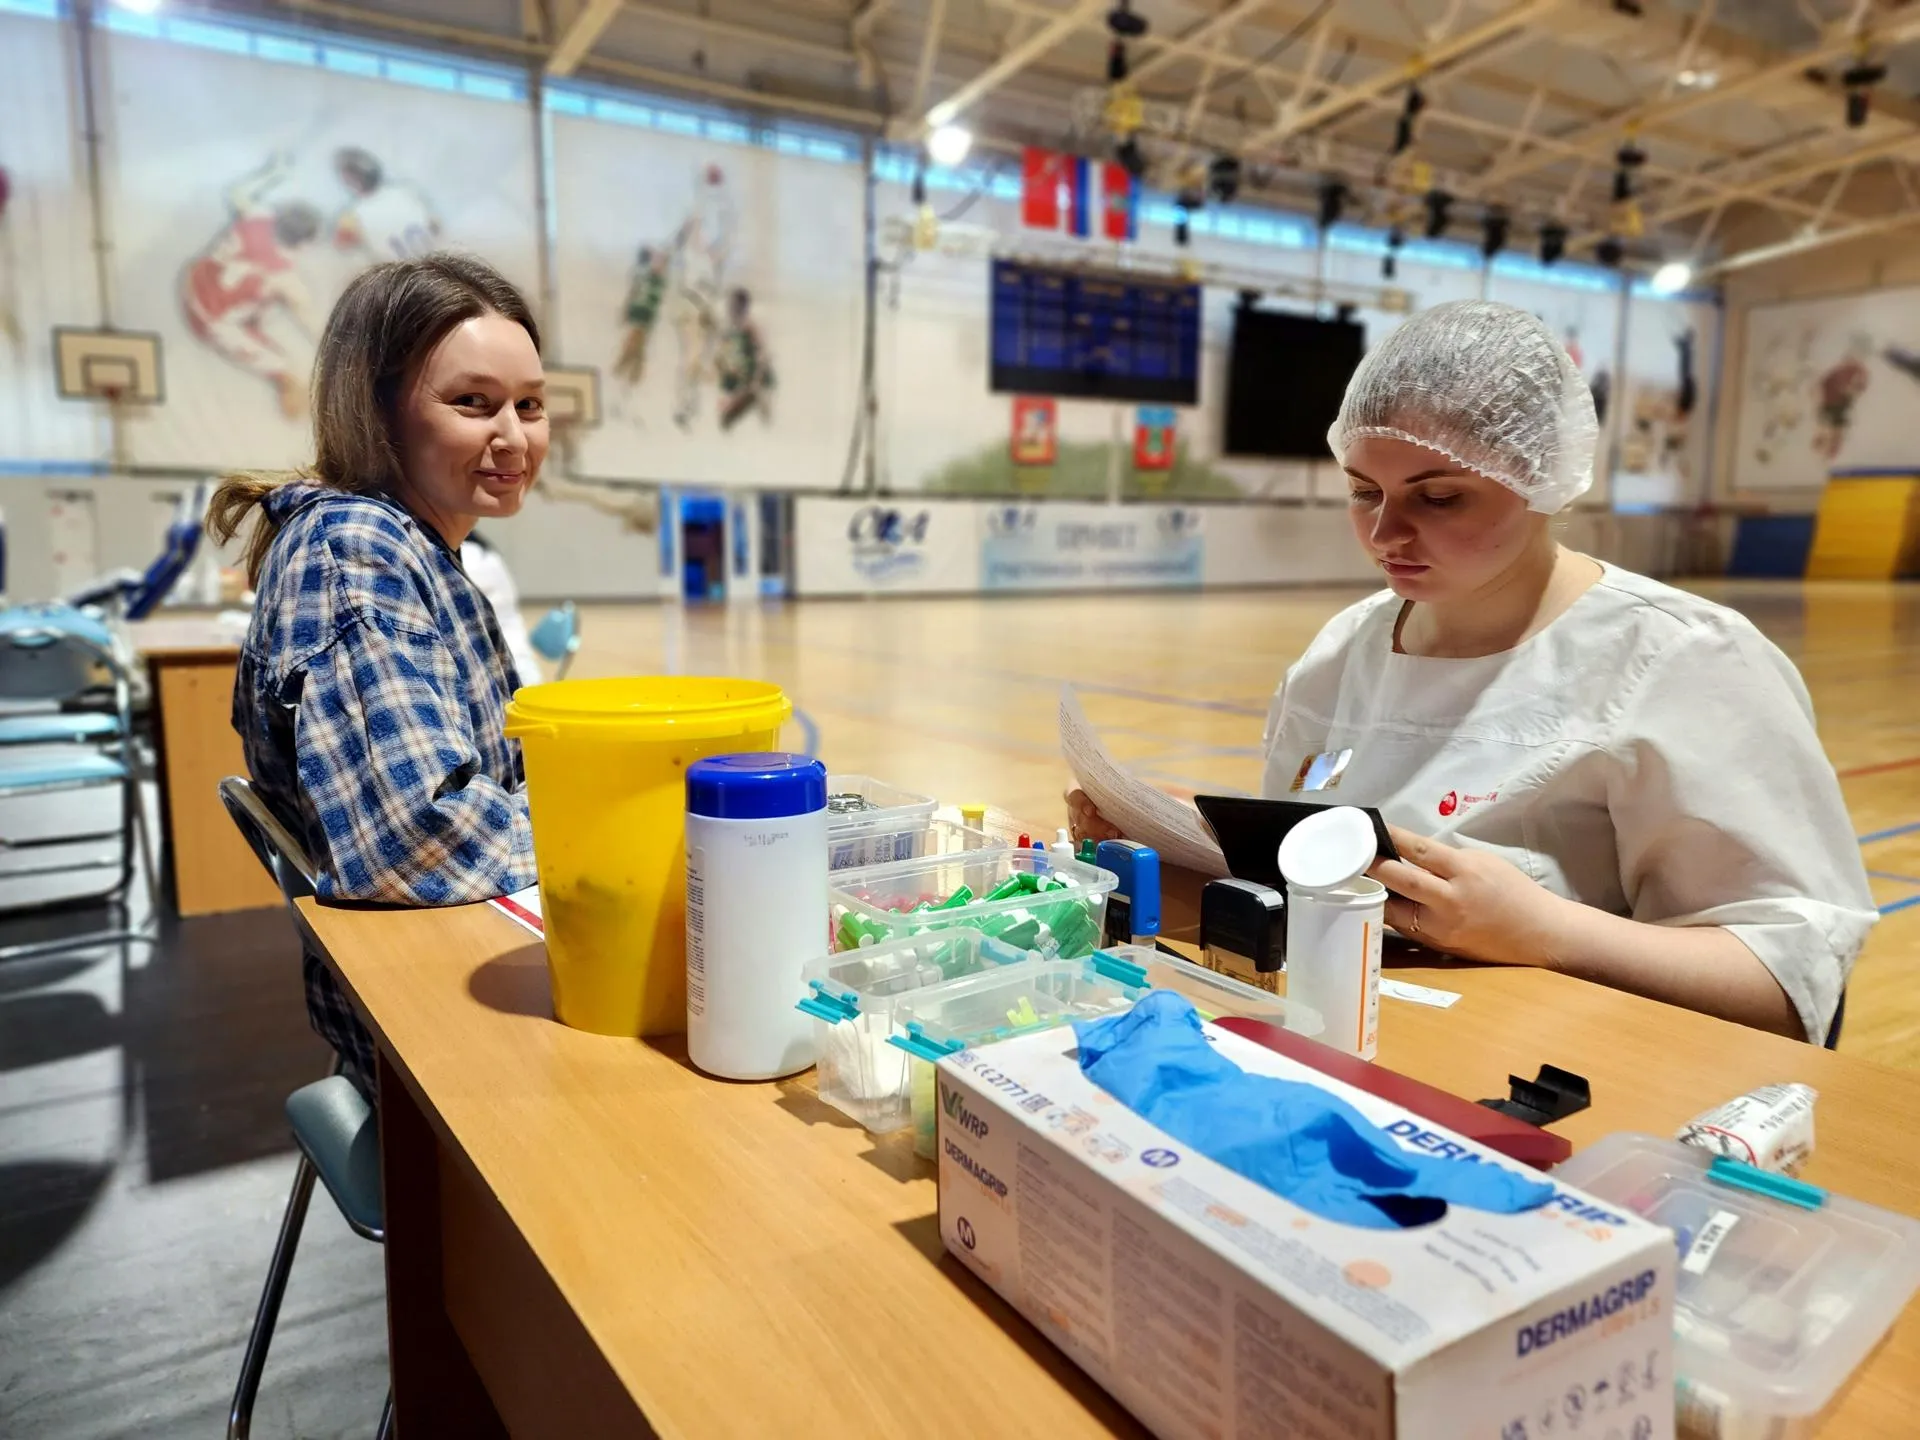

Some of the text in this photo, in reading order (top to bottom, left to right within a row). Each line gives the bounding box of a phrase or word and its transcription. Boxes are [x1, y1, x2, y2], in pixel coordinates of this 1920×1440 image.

[958, 1107, 989, 1139] WRP
[945, 1138, 1008, 1197] DERMAGRIP
[1516, 1269, 1656, 1357] DERMAGRIP
